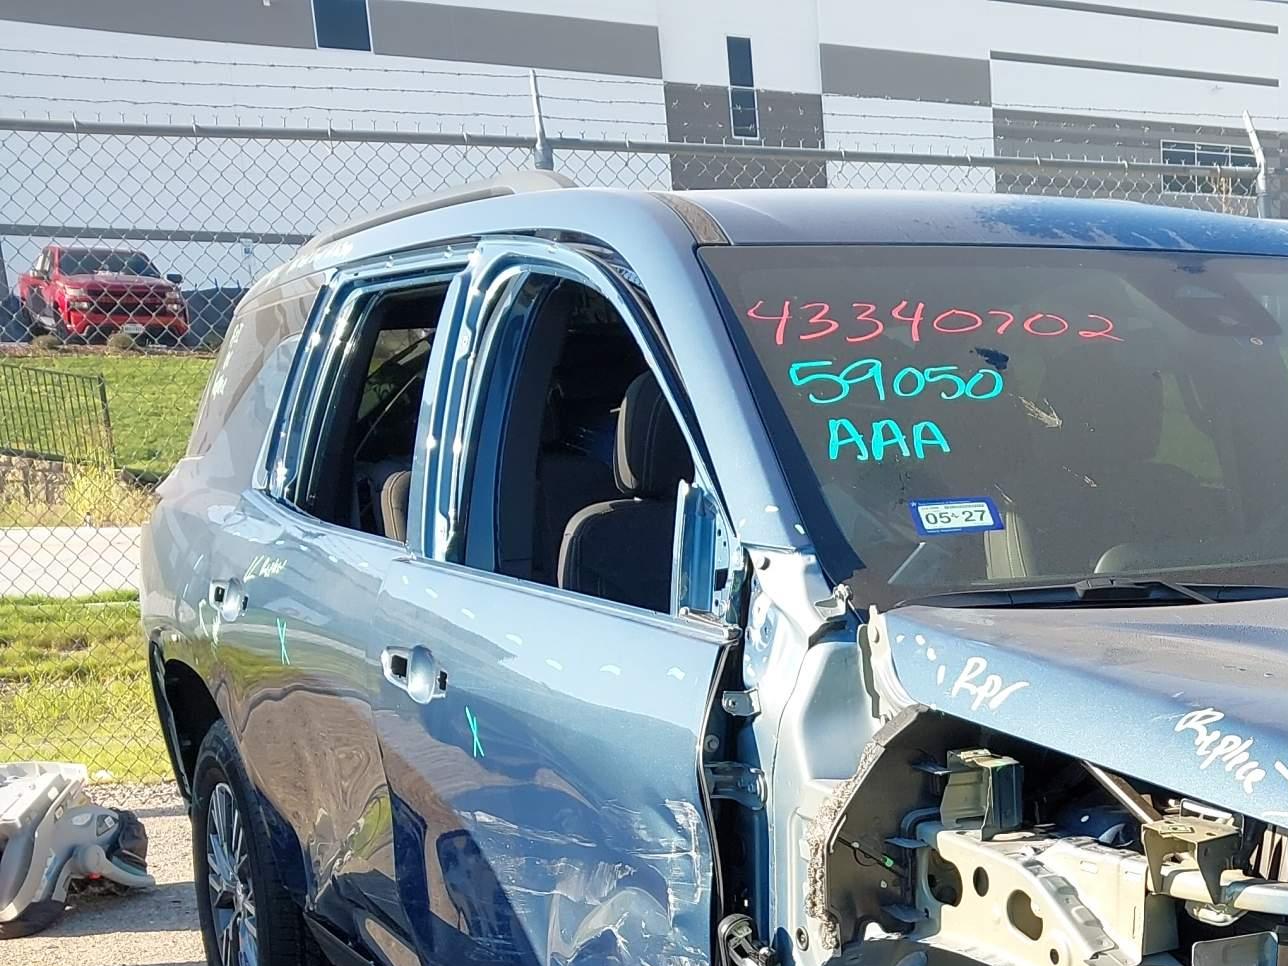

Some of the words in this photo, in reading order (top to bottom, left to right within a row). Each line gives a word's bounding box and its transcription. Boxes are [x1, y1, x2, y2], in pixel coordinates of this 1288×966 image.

[746, 300, 1125, 345] 43340702
[788, 358, 1004, 404] 59050
[827, 418, 951, 461] AAA
